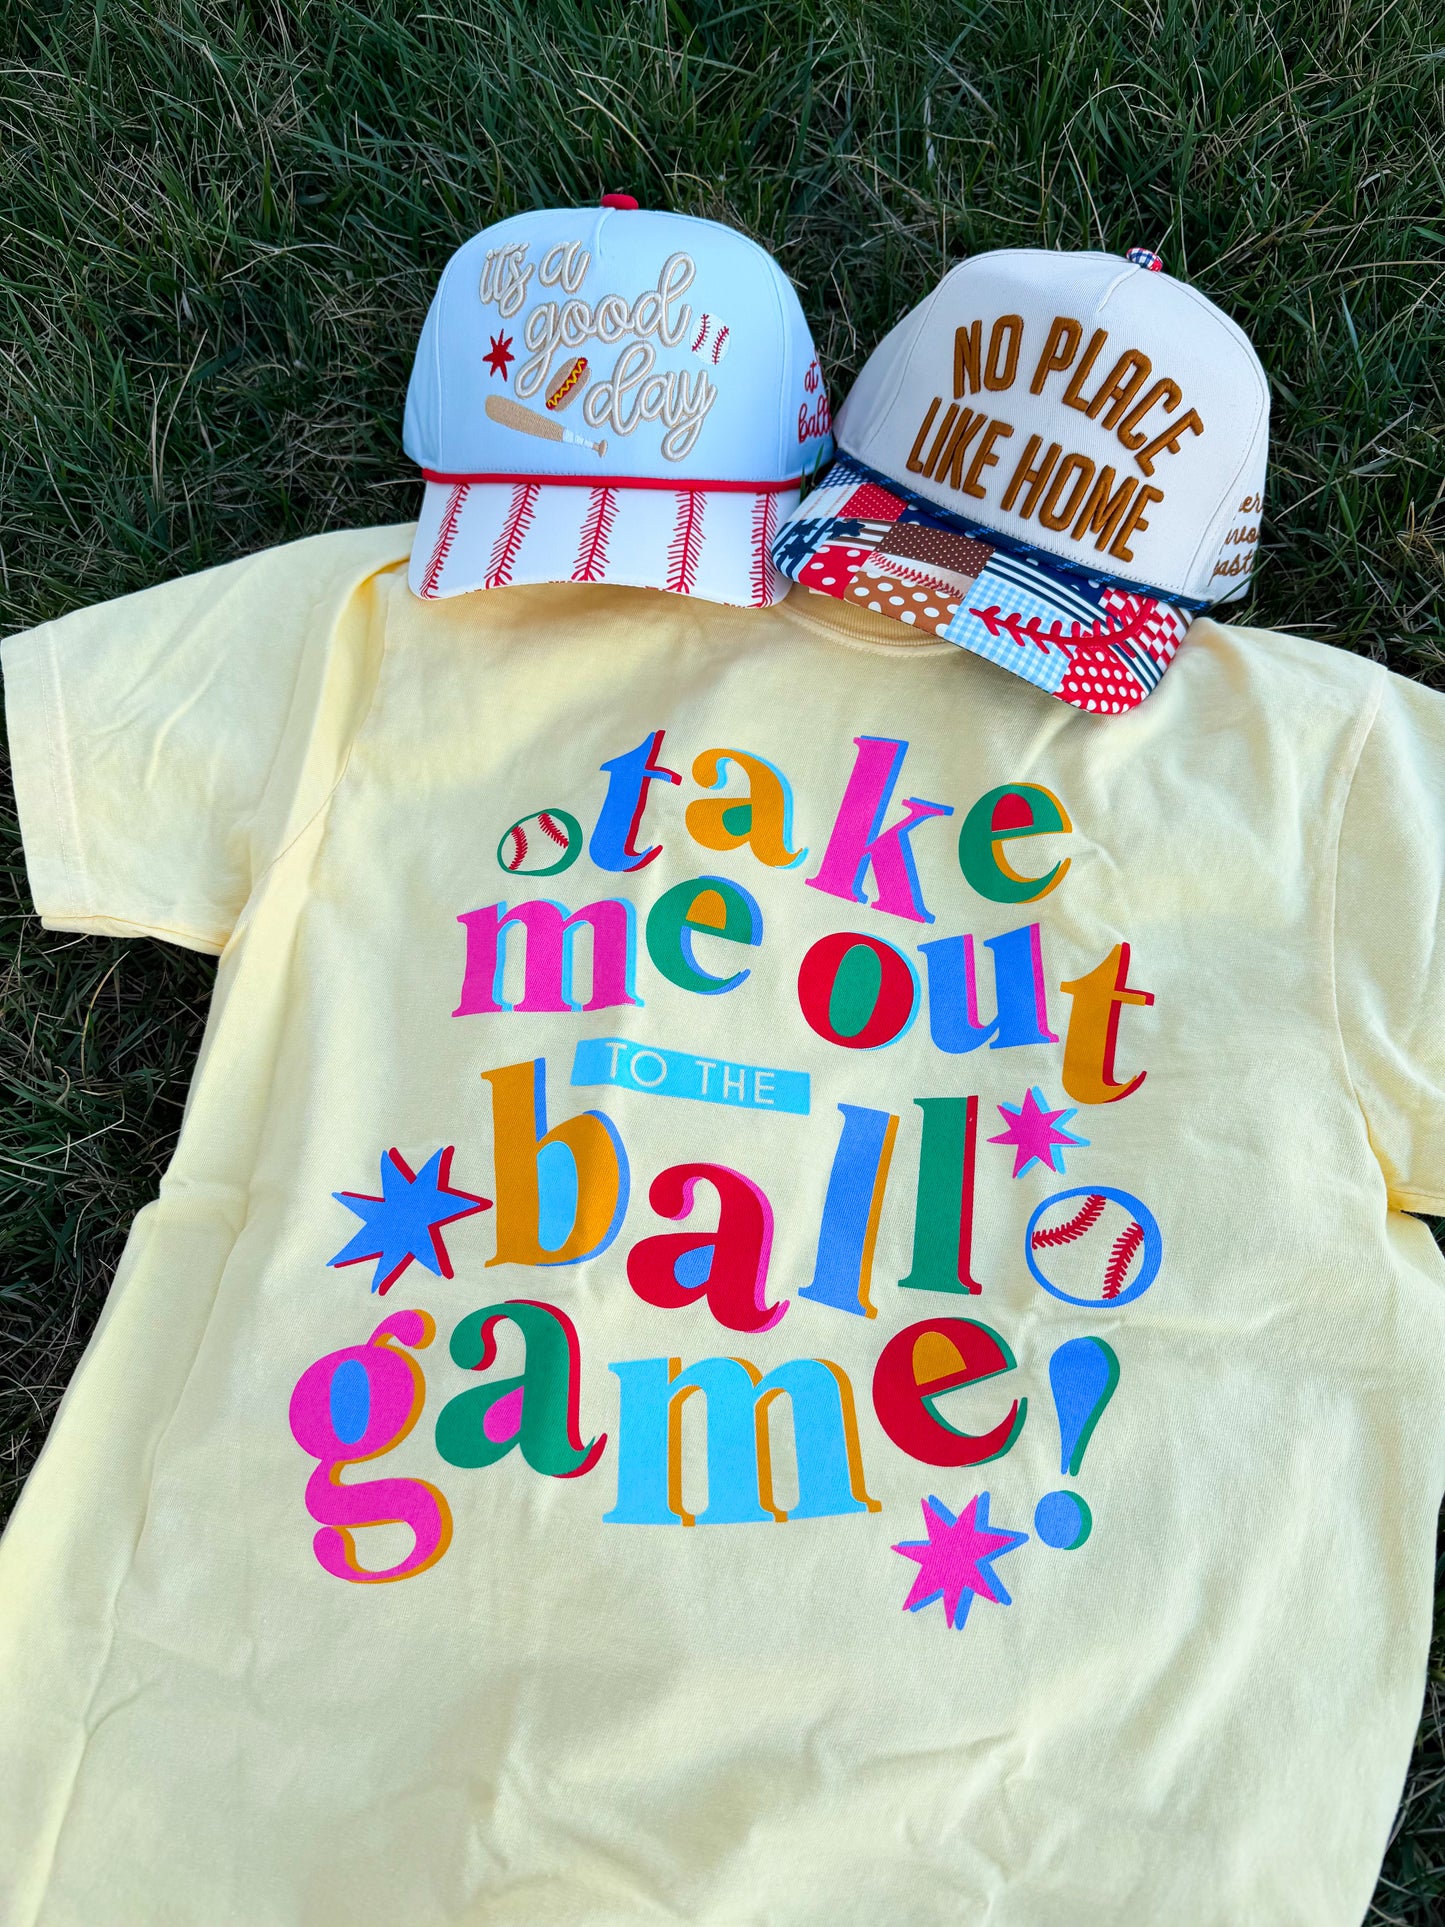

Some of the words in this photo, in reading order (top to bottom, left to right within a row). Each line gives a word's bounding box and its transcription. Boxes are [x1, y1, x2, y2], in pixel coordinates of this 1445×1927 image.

[515, 252, 696, 399] good
[539, 239, 592, 295] a
[583, 340, 718, 462] day
[798, 394, 832, 444] ball
[953, 314, 1024, 400] NO
[1030, 315, 1204, 477] PLACE
[905, 396, 1014, 500] LIKE
[1000, 434, 1165, 563] HOME
[589, 729, 1073, 924] take
[452, 875, 764, 1018] me
[798, 923, 1155, 1105] out
[605, 1041, 668, 1088] TO
[695, 1060, 775, 1105] THE
[481, 1057, 981, 1333] ball
[289, 1299, 1121, 1585] game!
